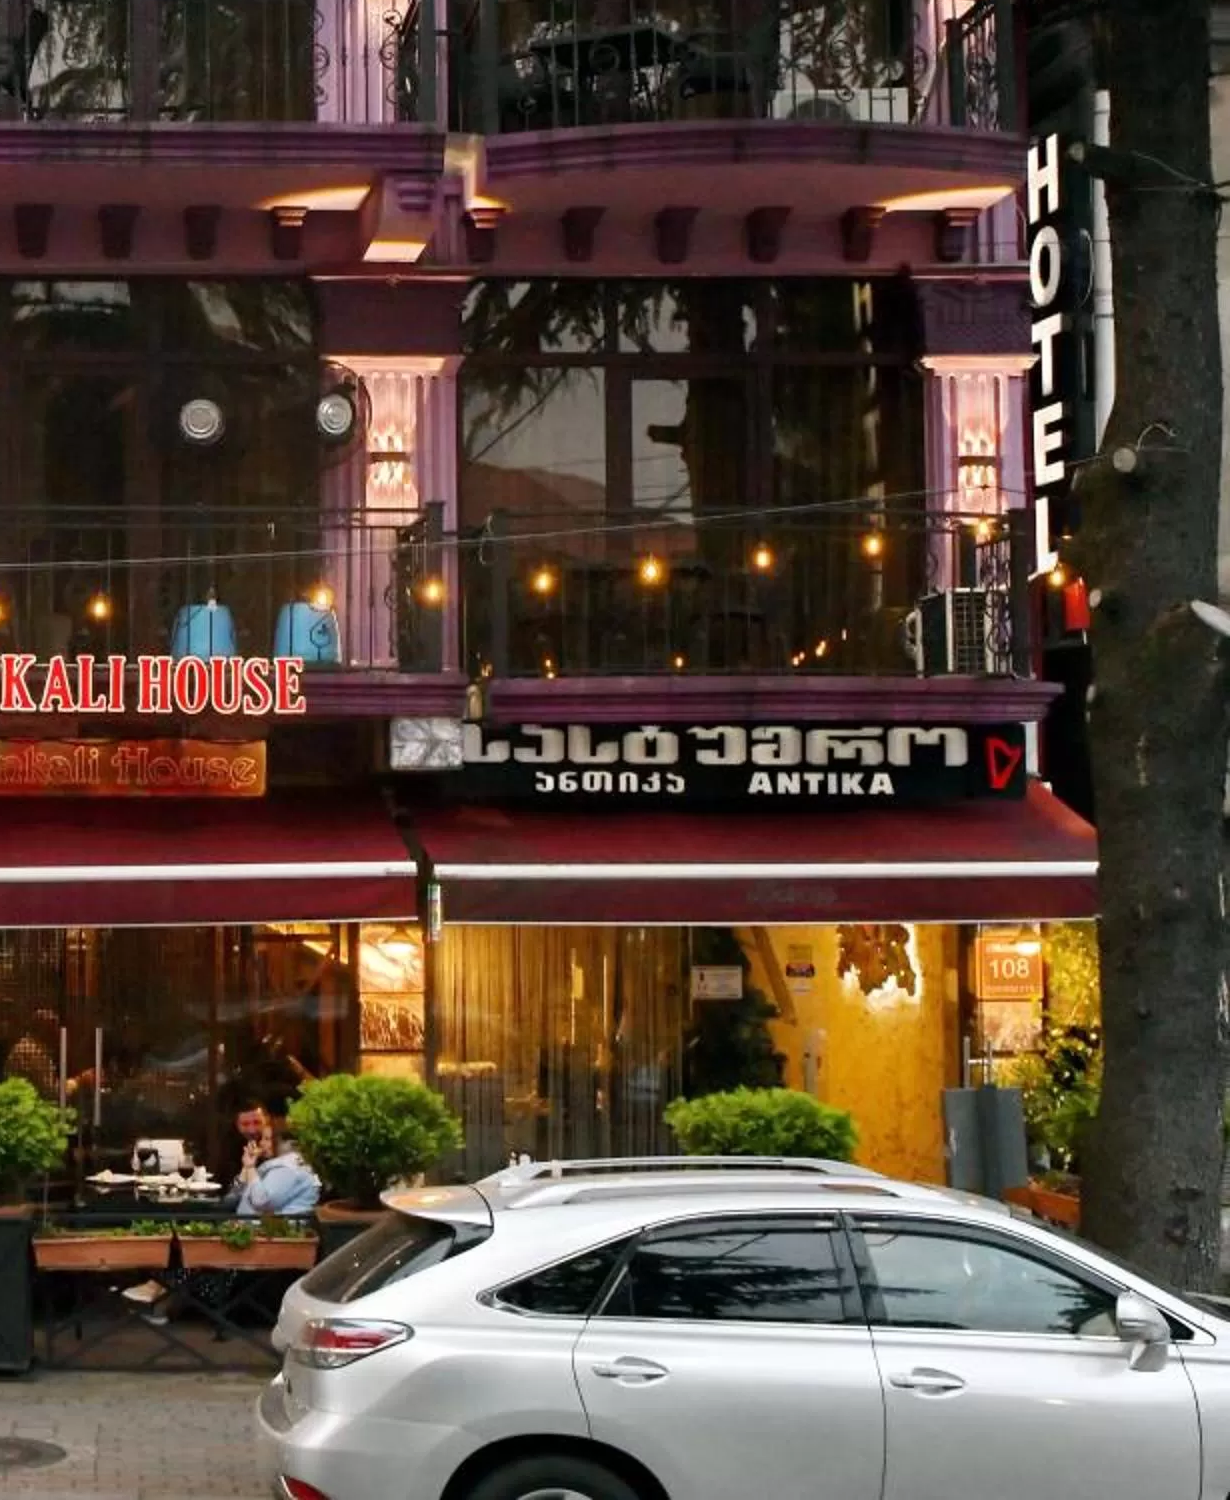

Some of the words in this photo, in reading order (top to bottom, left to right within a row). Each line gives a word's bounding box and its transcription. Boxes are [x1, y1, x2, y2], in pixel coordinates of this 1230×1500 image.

[1027, 132, 1065, 578] HOTEL
[137, 656, 307, 716] HOUSE
[462, 723, 968, 767] სასტუმრო
[535, 771, 686, 794] ანთიკა
[747, 771, 895, 795] ANTIKA
[989, 957, 1030, 980] 108
